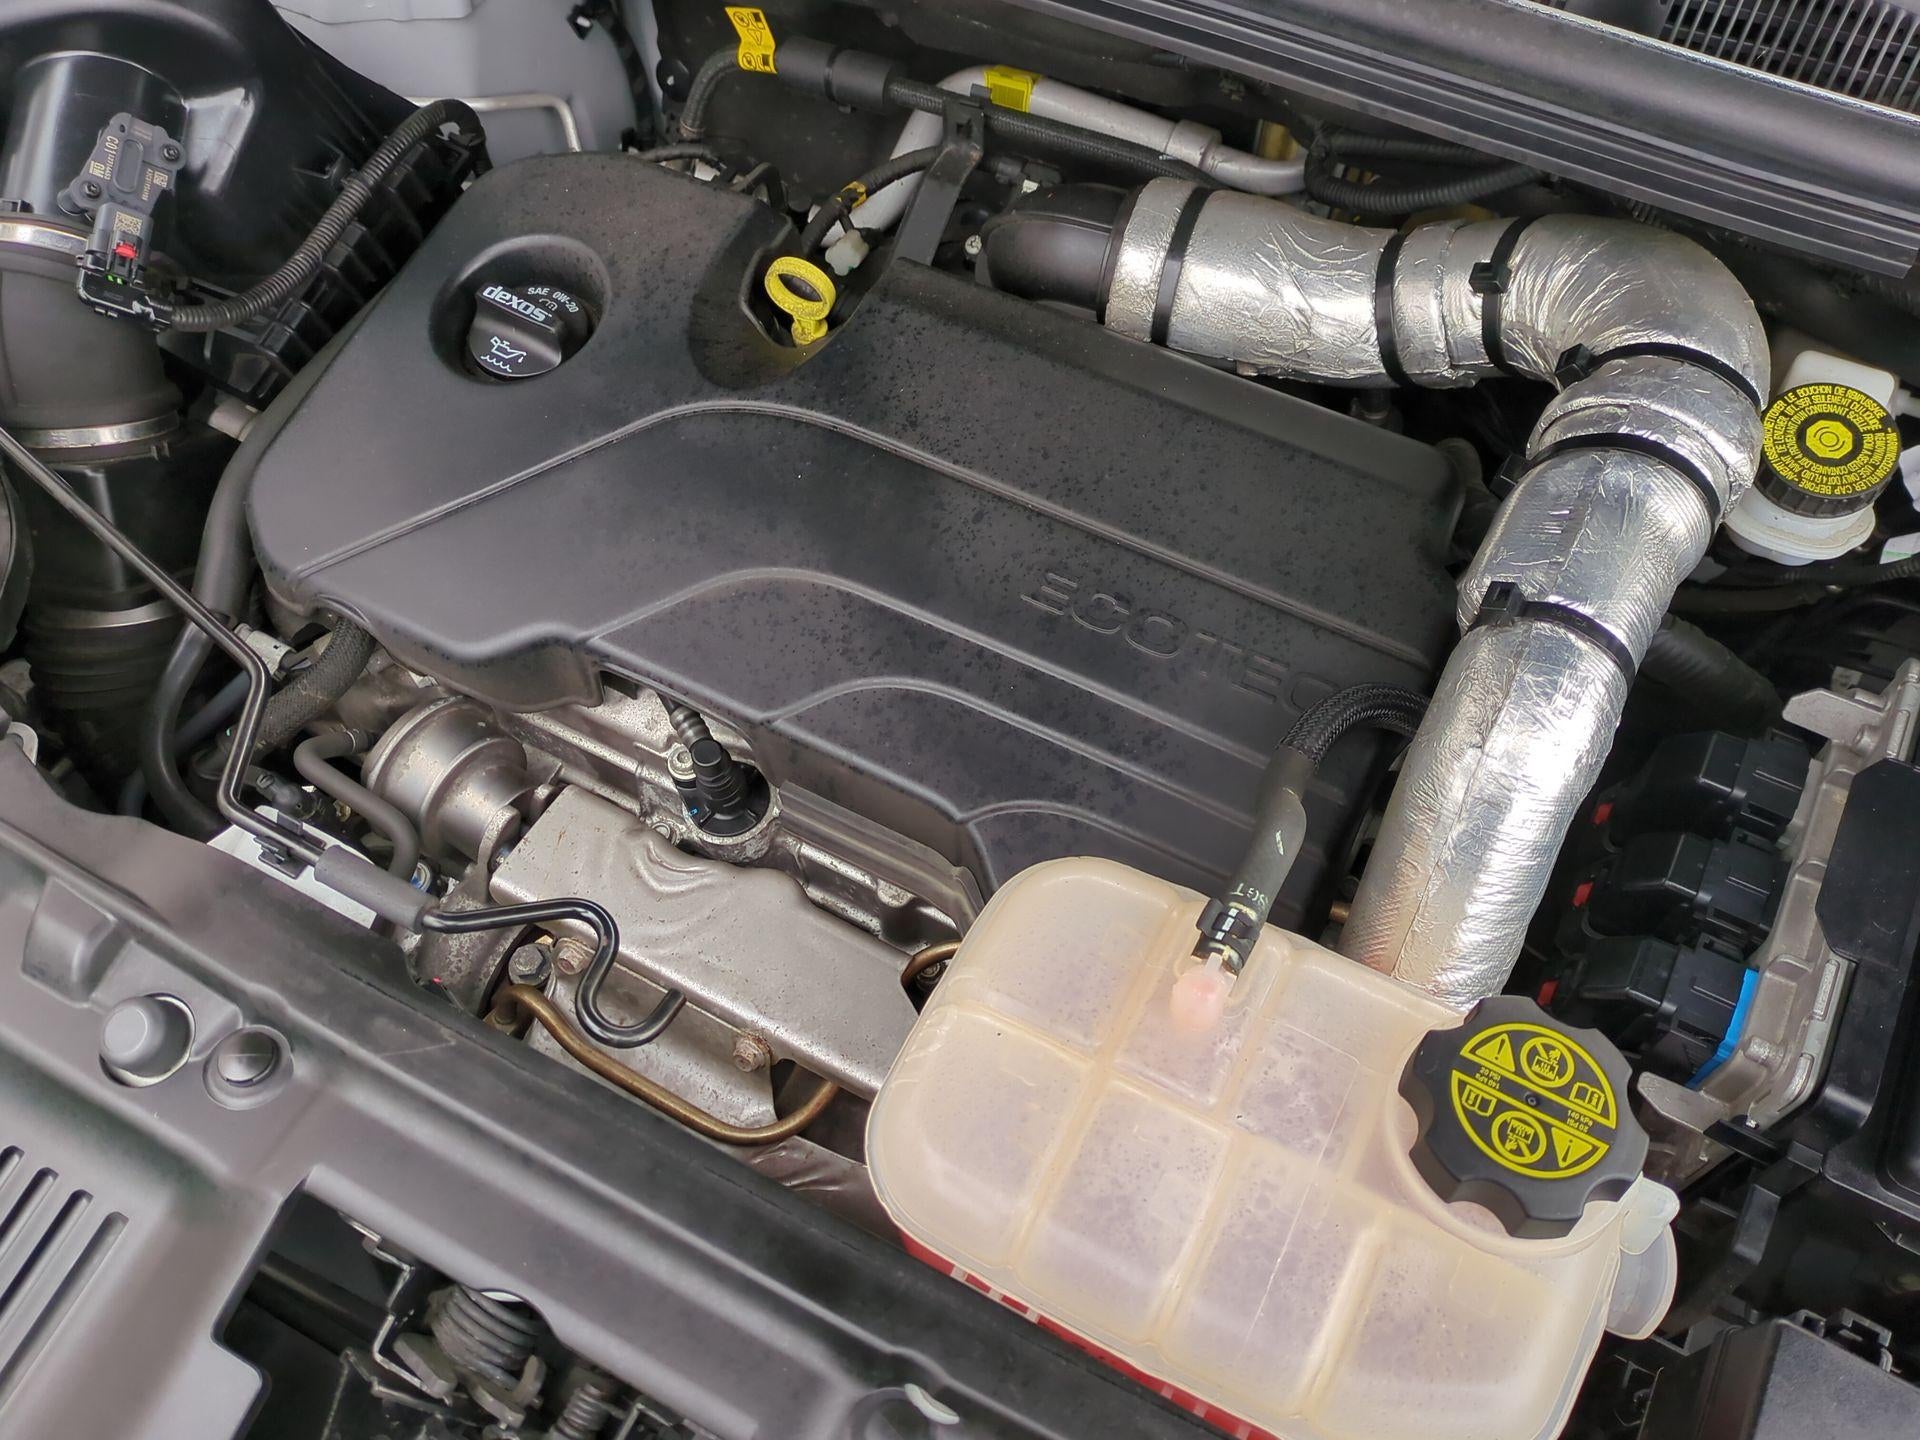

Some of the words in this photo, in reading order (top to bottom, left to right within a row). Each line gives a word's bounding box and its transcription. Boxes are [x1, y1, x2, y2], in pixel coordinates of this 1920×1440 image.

[91, 162, 105, 178] GM
[482, 286, 549, 322] dexos
[552, 292, 579, 313] 0W-20
[1783, 391, 1798, 404] LE
[1795, 385, 1832, 398] BOUCHON
[1834, 386, 1847, 397] DE
[1797, 477, 1832, 496] BEFORE
[1827, 475, 1842, 485] DOT
[1834, 484, 1854, 495] CAP
[1567, 1110, 1579, 1120] 140
